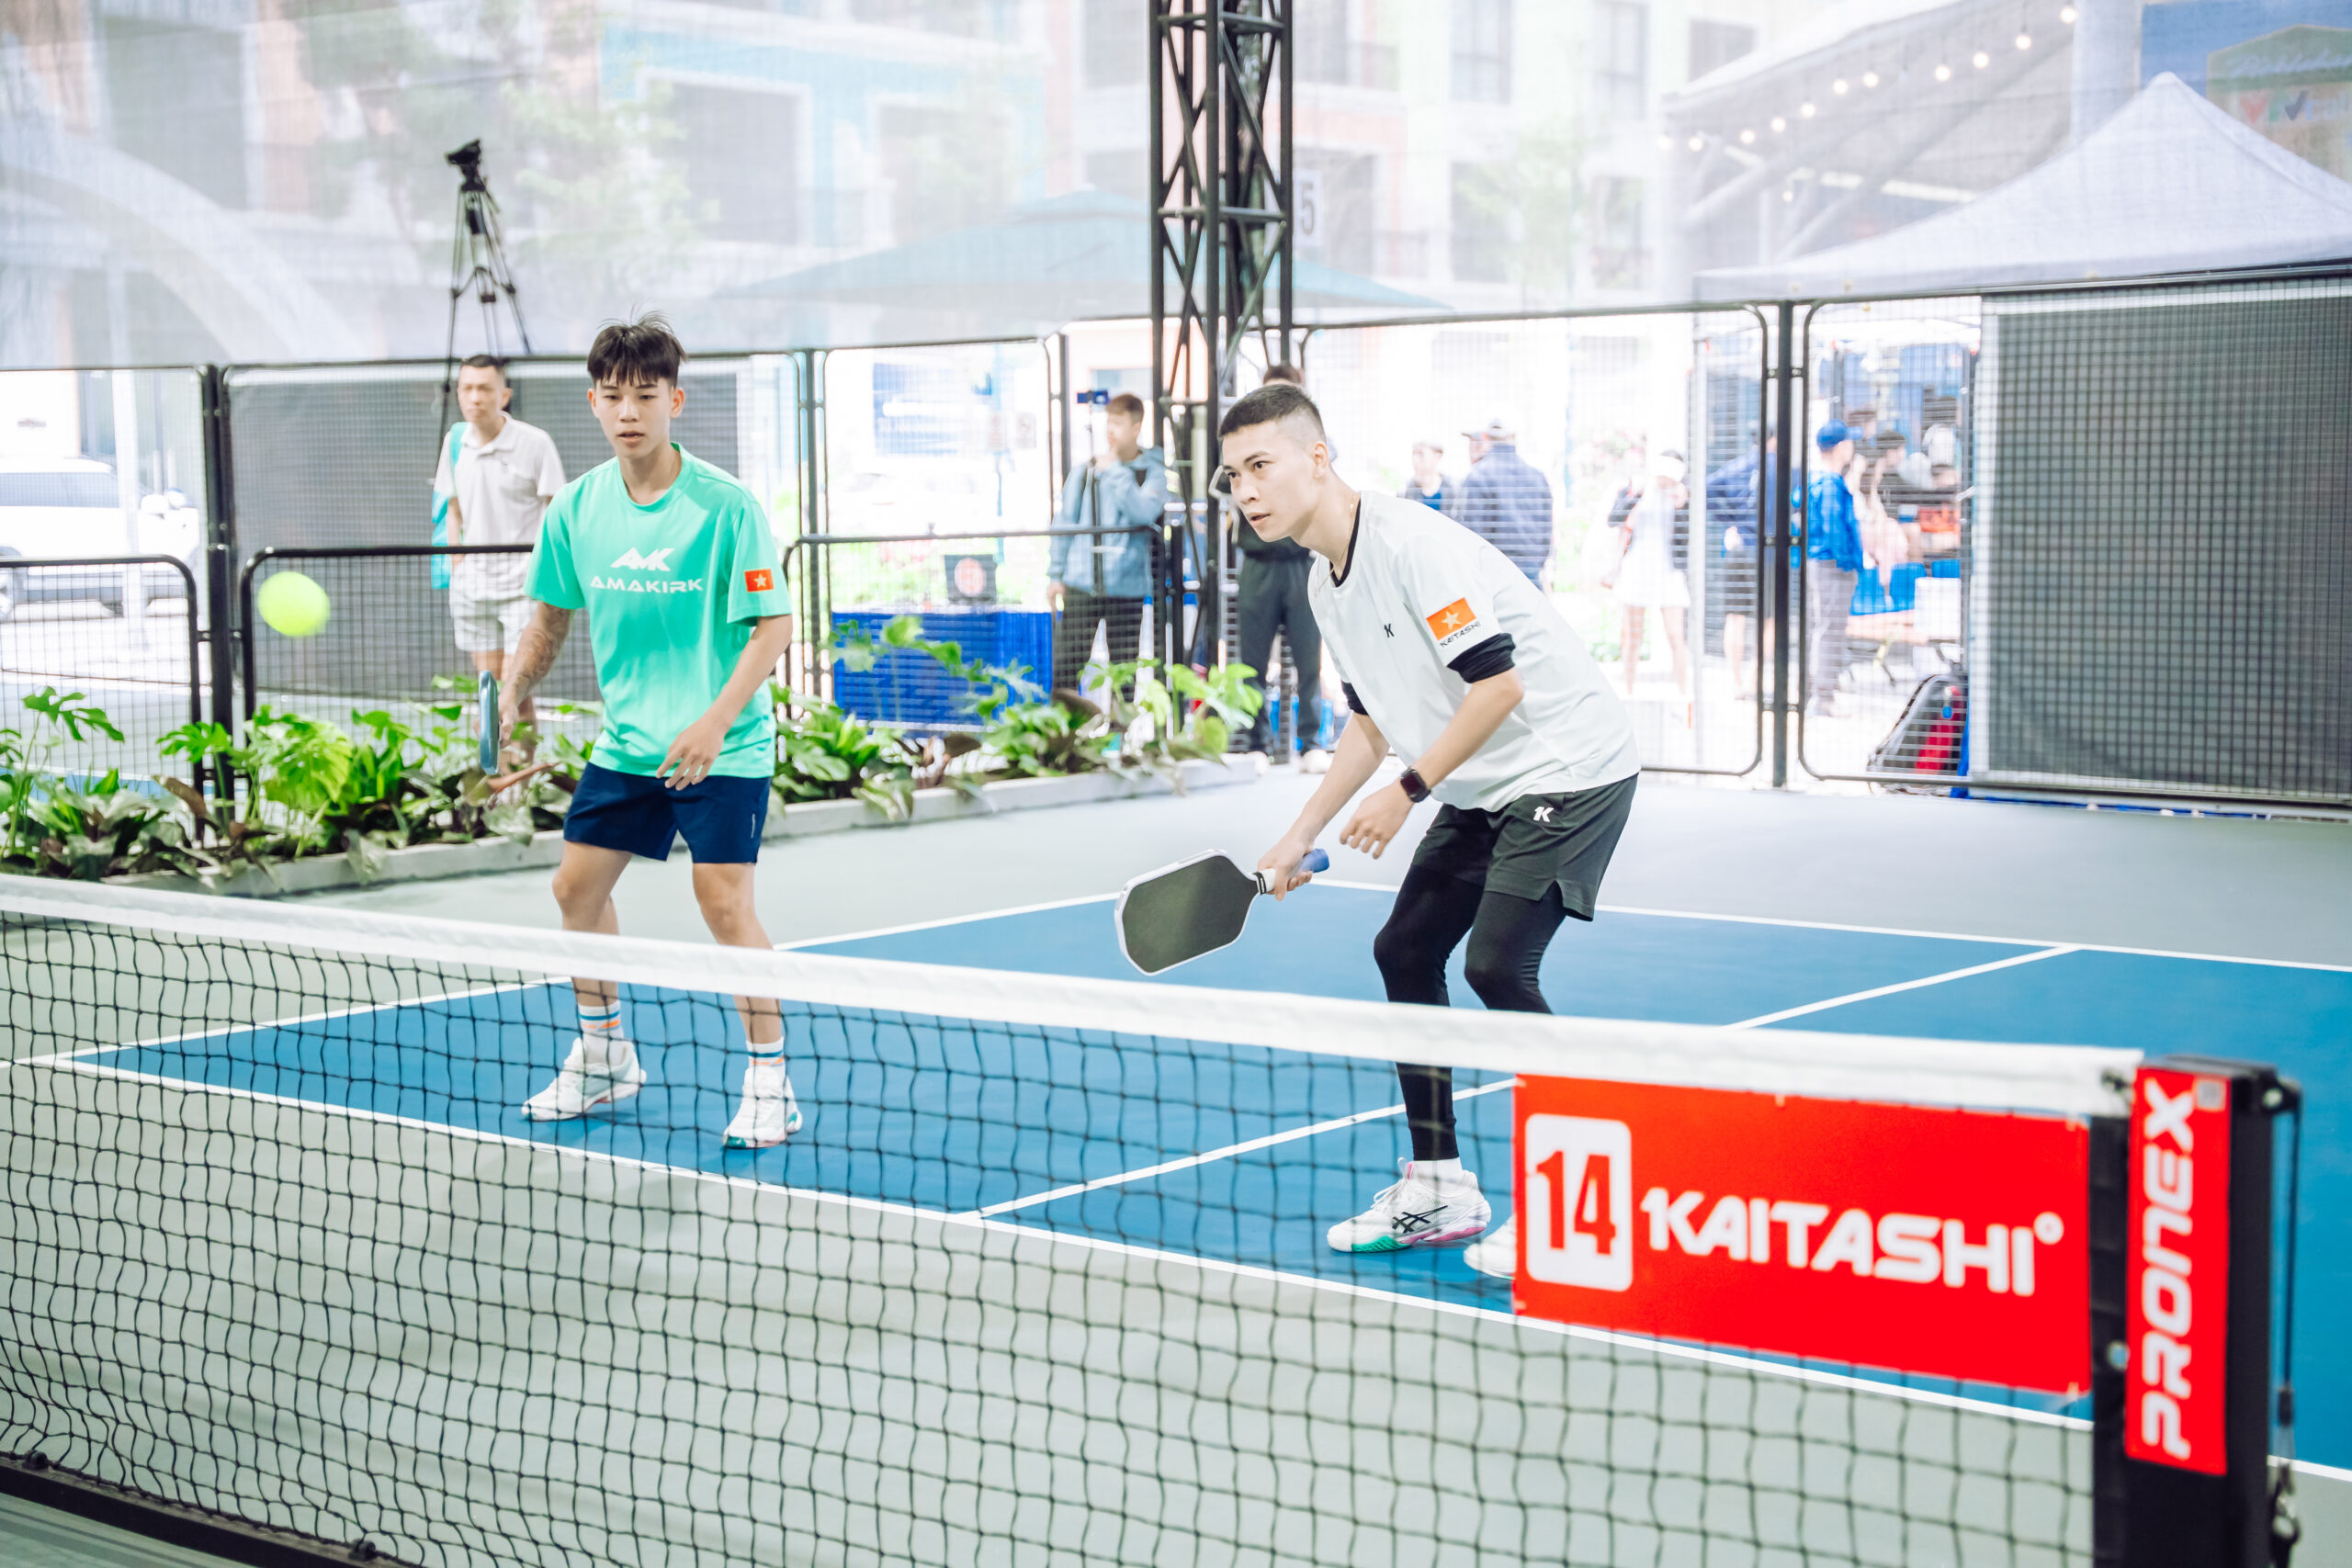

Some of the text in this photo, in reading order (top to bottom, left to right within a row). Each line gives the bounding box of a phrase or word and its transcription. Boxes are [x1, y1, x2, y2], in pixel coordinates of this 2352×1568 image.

[590, 575, 703, 593] AMAKIRK
[1440, 620, 1481, 647] KAITASHI
[1536, 1150, 1616, 1255] 14
